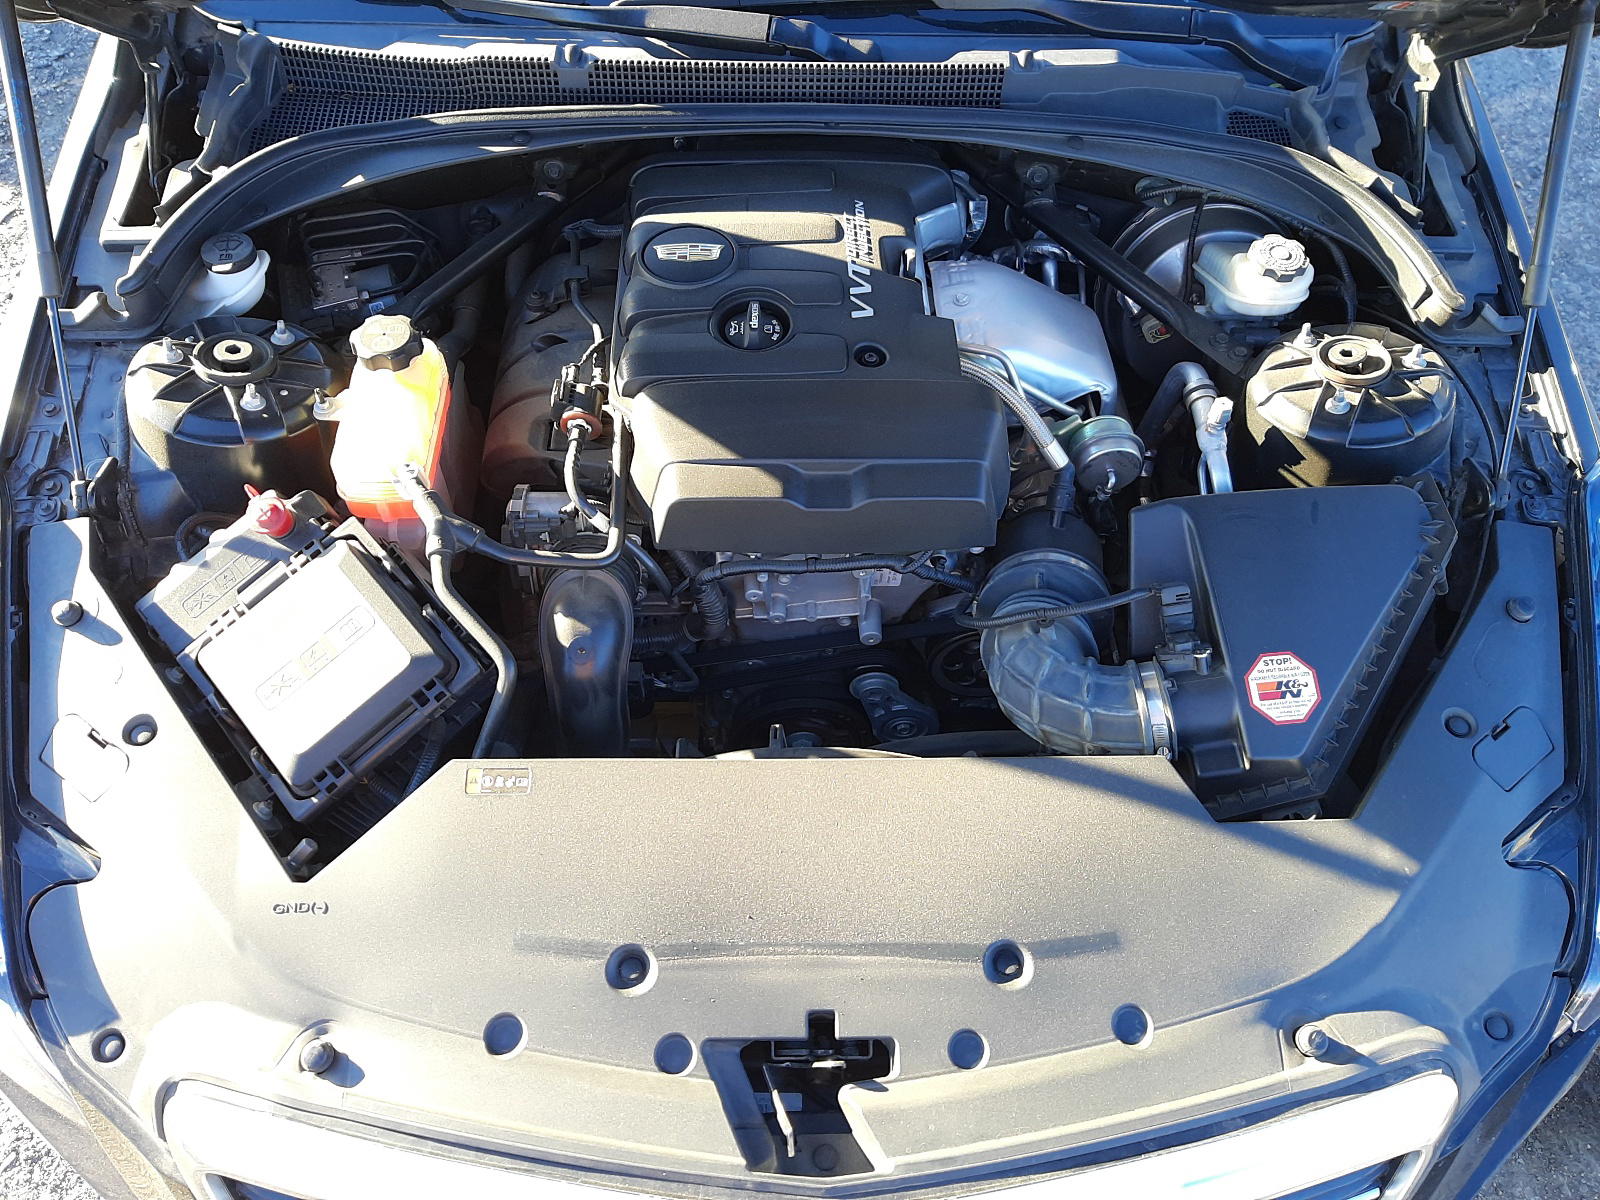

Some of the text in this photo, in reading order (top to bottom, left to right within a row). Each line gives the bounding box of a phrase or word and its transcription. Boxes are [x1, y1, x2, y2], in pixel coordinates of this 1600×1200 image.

[844, 211, 858, 257] DIRECT
[855, 200, 873, 263] INJECTION
[848, 257, 874, 319] VVT
[750, 303, 759, 329] dexos
[1263, 657, 1292, 667] STOP!
